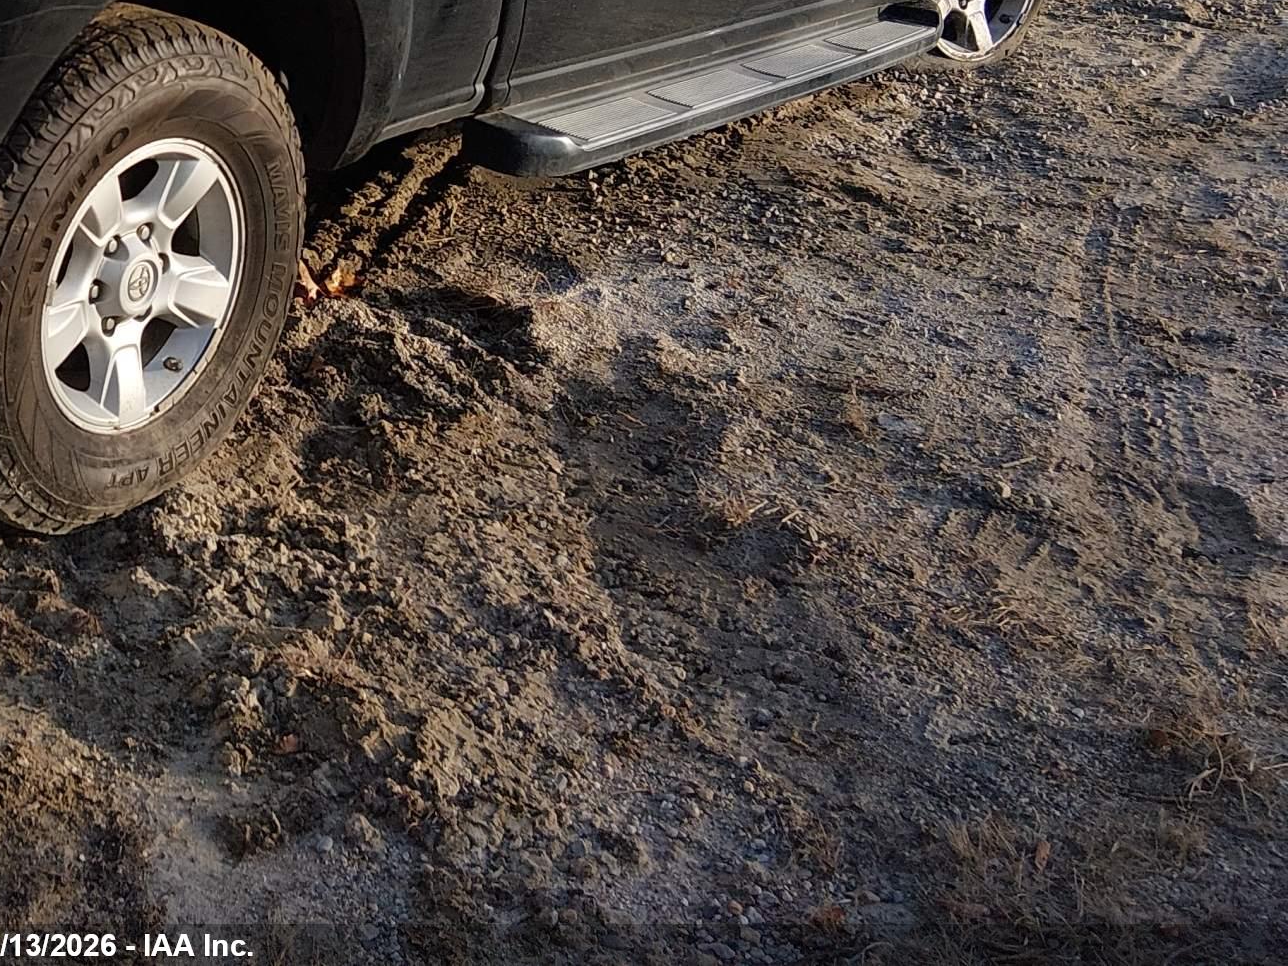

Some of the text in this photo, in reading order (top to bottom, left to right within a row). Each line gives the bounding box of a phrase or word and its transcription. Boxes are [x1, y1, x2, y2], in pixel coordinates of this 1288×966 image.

[19, 126, 130, 318] KUMHO
[265, 160, 291, 251] MAVIS
[158, 262, 288, 477] MOUNTAINEER
